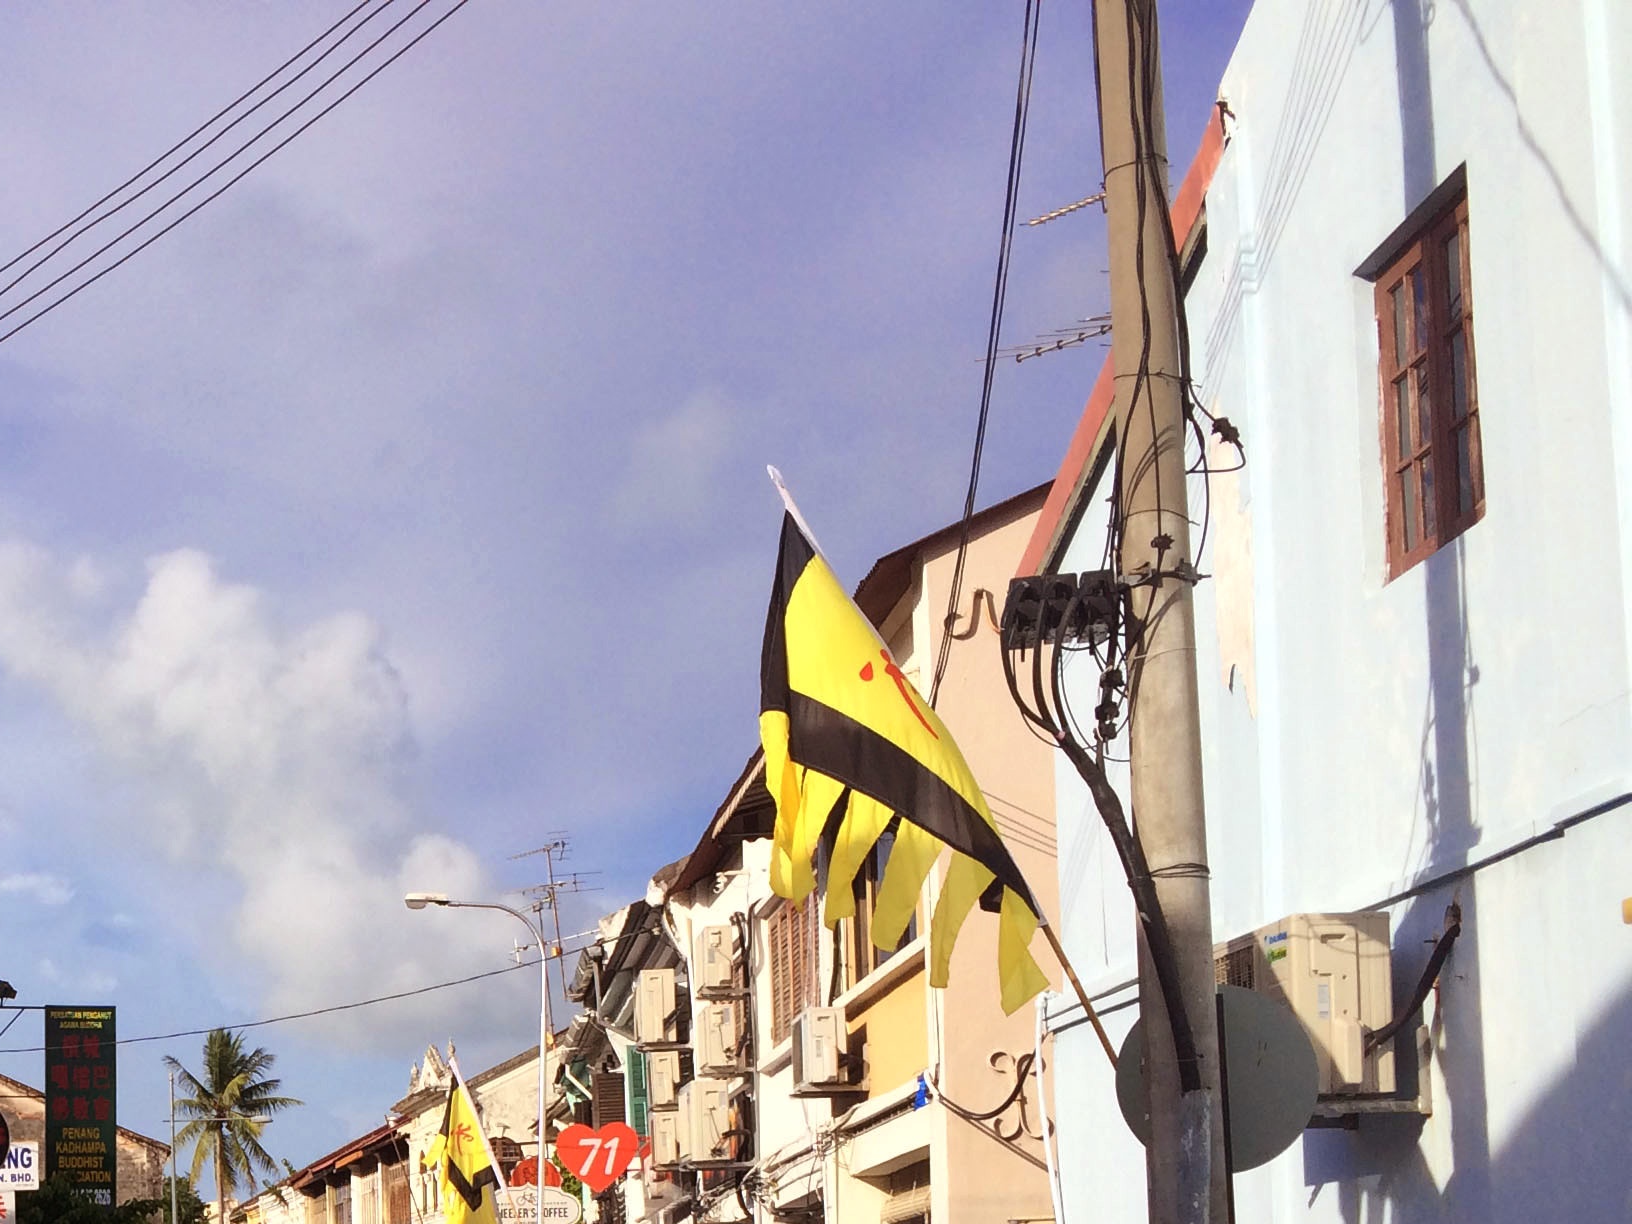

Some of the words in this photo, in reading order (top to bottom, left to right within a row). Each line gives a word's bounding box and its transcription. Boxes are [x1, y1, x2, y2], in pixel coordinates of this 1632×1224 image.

[62, 1127, 100, 1141] PENANG
[55, 1141, 107, 1154] KADHAMPA
[2, 1147, 33, 1170] NG
[58, 1156, 104, 1169] BUDDHIST
[577, 1137, 620, 1177] 71
[10, 1173, 35, 1183] BHD.
[543, 1207, 569, 1218] OFFEE
